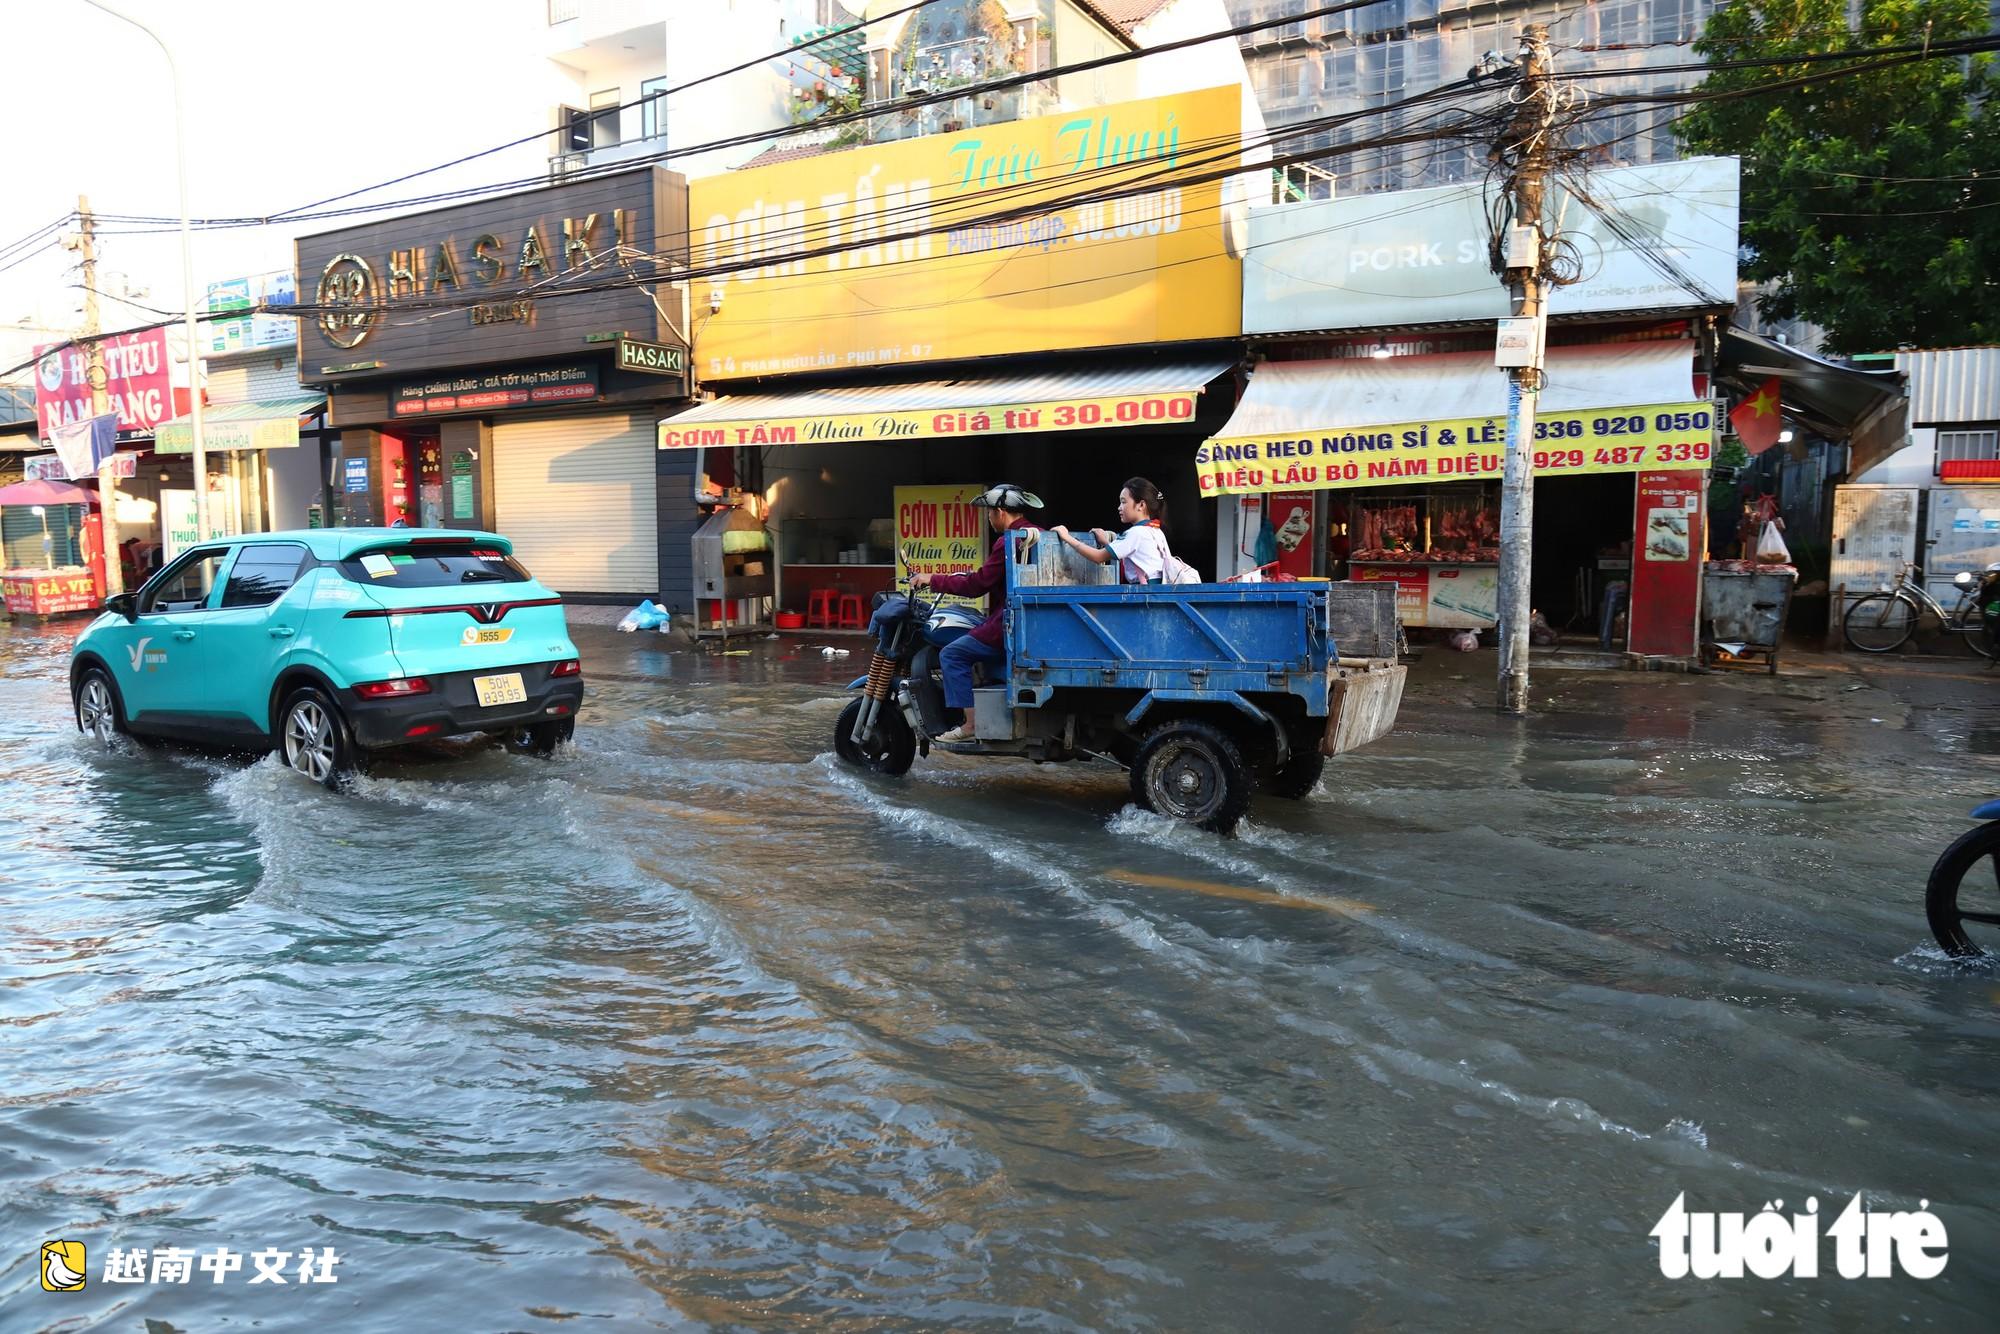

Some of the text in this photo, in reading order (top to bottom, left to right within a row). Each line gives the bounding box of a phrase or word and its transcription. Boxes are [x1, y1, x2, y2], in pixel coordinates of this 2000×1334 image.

[948, 139, 1040, 192] Trúc
[704, 164, 931, 288] CƠM TẤM
[388, 208, 626, 299] HASAKI
[1350, 242, 1442, 273] PORK
[623, 344, 681, 370] HASAKI
[402, 387, 423, 397] Hàng
[425, 381, 451, 394] CHÍNH
[453, 379, 478, 390] HÃNG
[484, 375, 500, 388] GIÁ
[502, 373, 520, 386] TỐT
[521, 372, 538, 386] Mọi
[665, 397, 1192, 448] CƠM TẤM Nhân Đức Giá từ 30.000
[1196, 443, 1257, 464] SÁNG
[1266, 439, 1313, 458] HEO
[1321, 433, 1393, 454] NÓNG
[1402, 424, 1429, 448] SỈ
[1437, 428, 1457, 445] &
[1466, 420, 1505, 444] LẺ:
[1592, 415, 1646, 436] 920
[1655, 411, 1710, 432] 050
[1200, 466, 1264, 490] CHIỀU
[1272, 461, 1317, 485] LẨU
[1326, 459, 1359, 481] BÒ
[1367, 457, 1428, 479] NĂM
[1437, 452, 1505, 476] DIỆU:
[1593, 445, 1647, 465] 487
[1656, 442, 1710, 463] 339
[900, 490, 979, 538] CƠM TẤM
[948, 541, 977, 560] Đức
[480, 631, 499, 642] 1555
[489, 676, 511, 690] 50H
